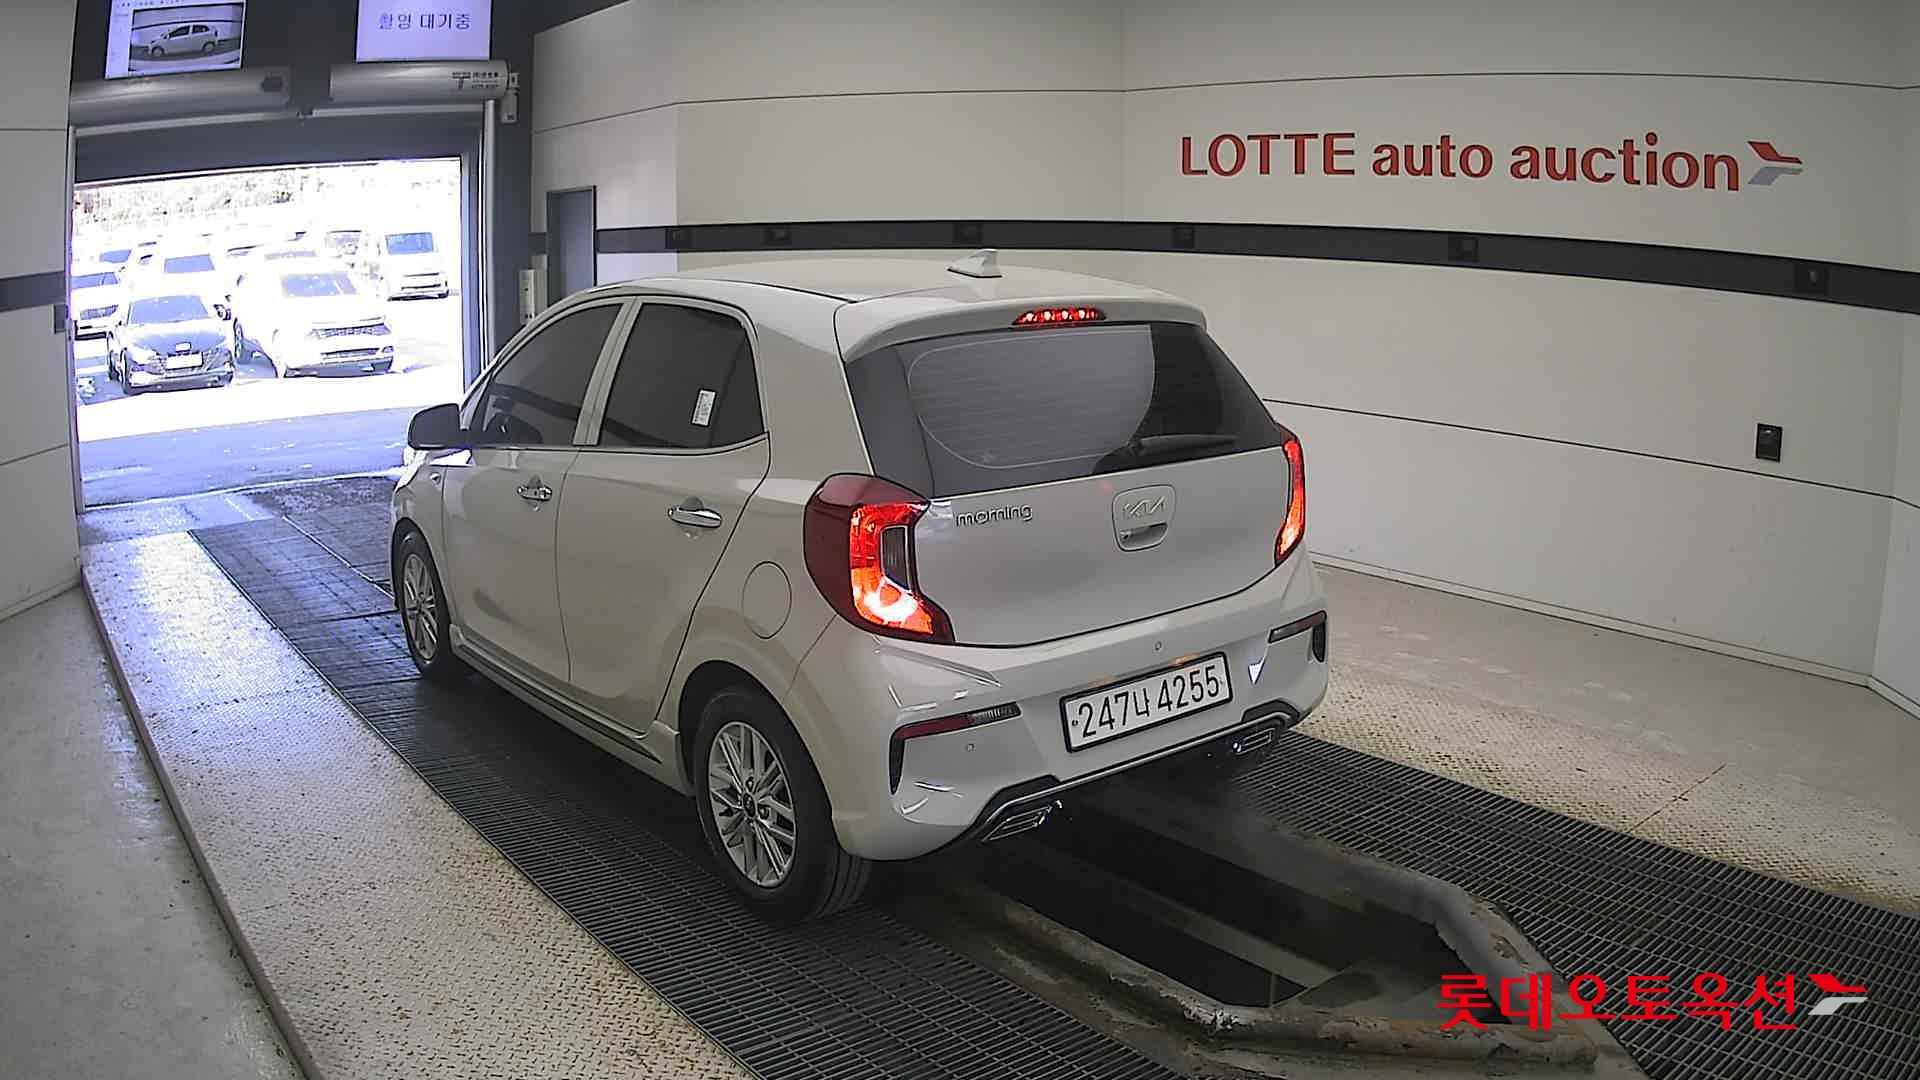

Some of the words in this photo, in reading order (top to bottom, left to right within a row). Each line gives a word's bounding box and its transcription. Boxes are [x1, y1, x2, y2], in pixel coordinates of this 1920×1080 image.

[420, 13, 473, 30] 대기중
[1181, 132, 1356, 177] LOTTE
[1372, 134, 1494, 178] auto
[1510, 131, 1740, 192] auction
[956, 503, 1033, 528] morning
[1078, 688, 1150, 738] 247나
[1157, 664, 1220, 712] 4255
